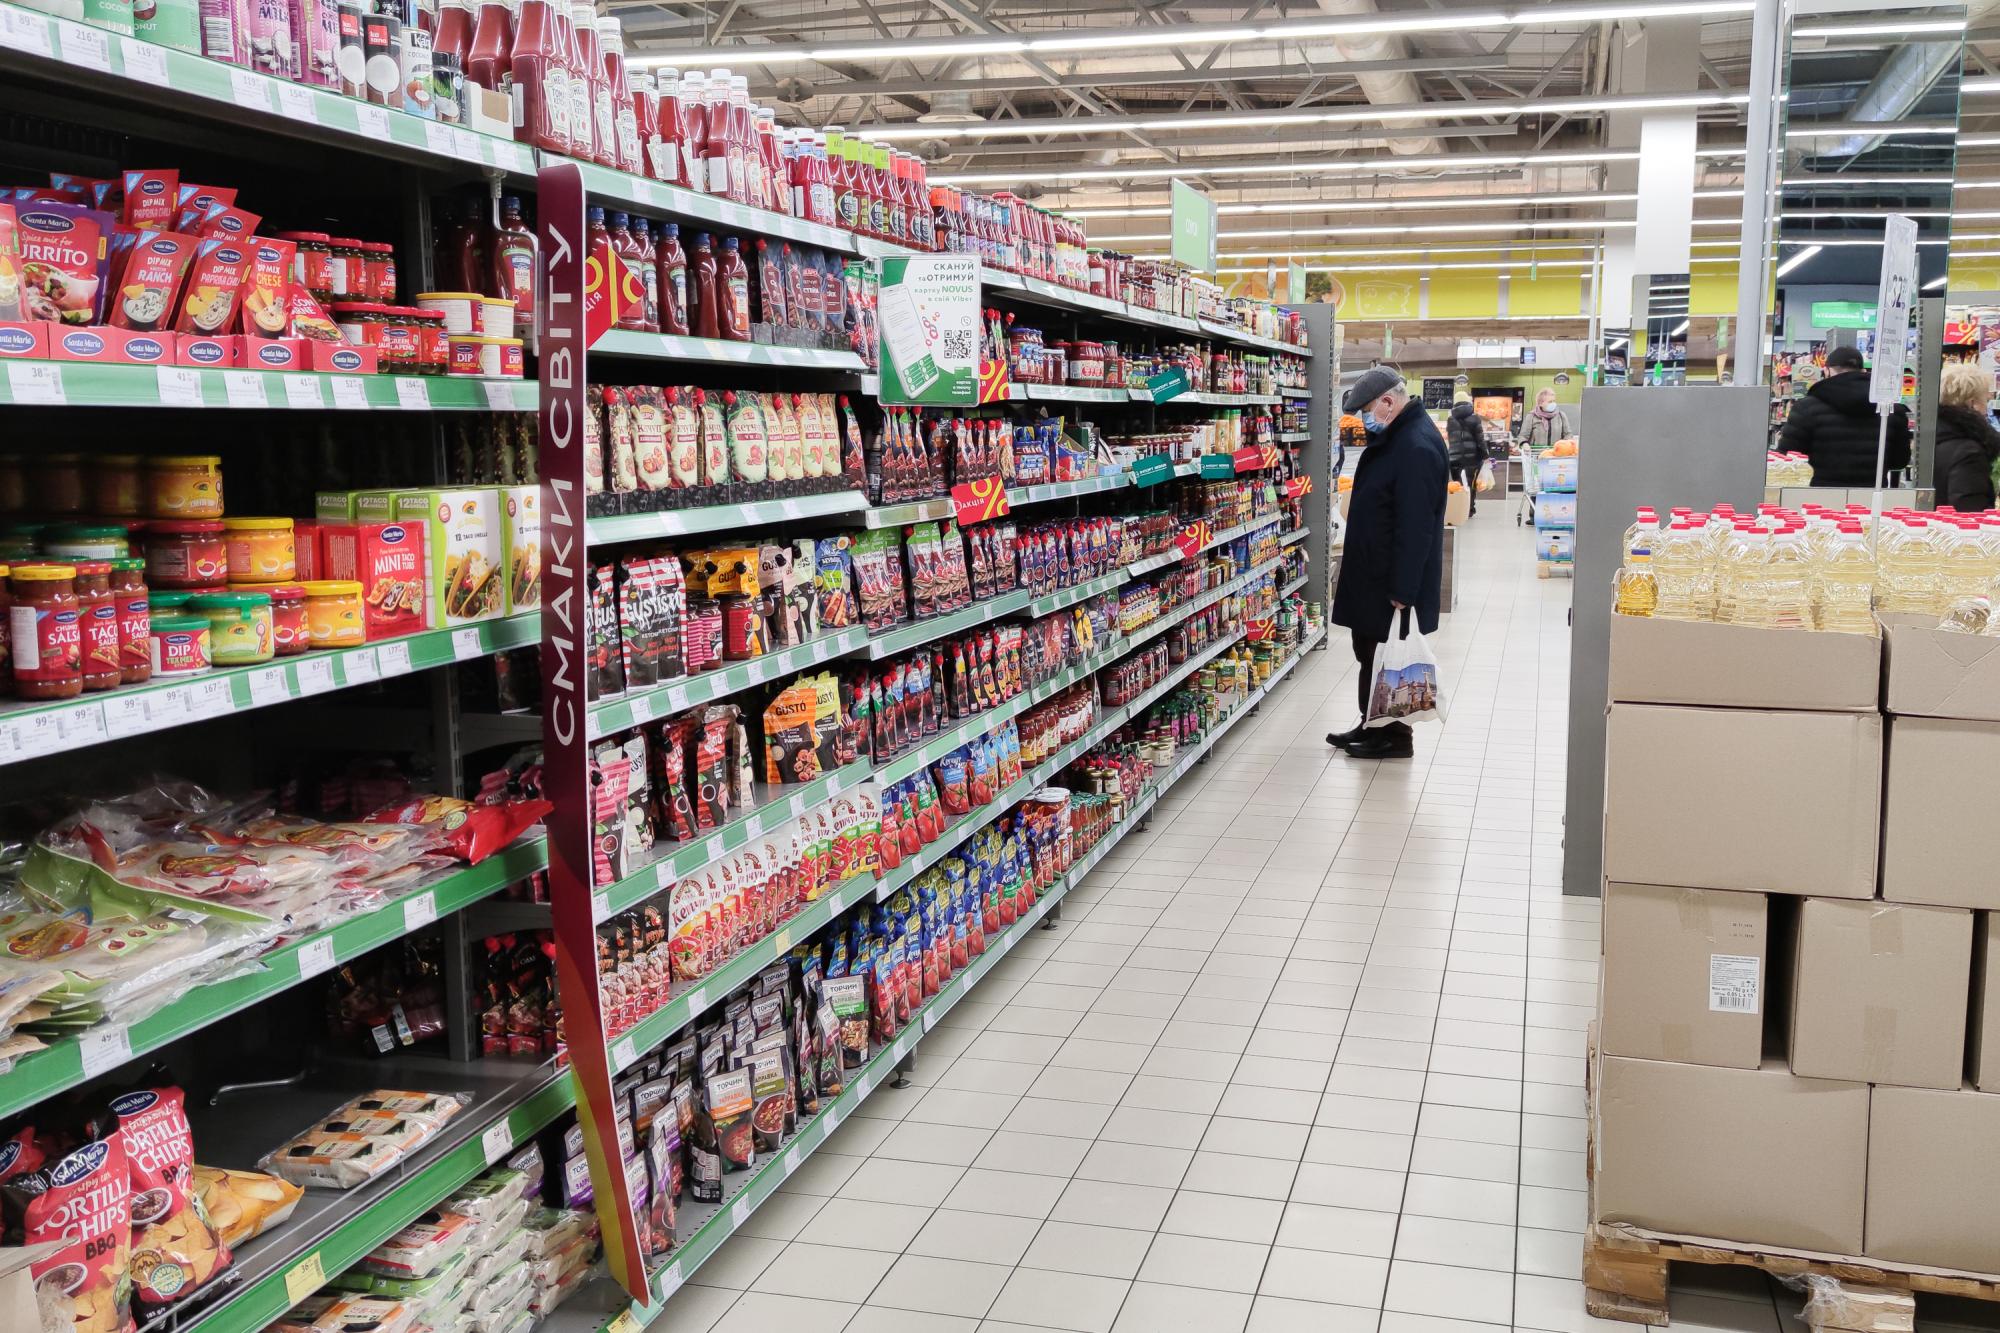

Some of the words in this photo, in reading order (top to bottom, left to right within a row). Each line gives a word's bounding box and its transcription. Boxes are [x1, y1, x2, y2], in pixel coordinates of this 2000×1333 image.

[75, 29, 92, 42] 216
[153, 198, 165, 206] MIX
[24, 216, 46, 227] Santa
[47, 218, 71, 229] Maria
[213, 231, 226, 240] DIP
[43, 235, 58, 245] mix
[59, 234, 74, 249] for
[147, 257, 160, 265] DIP
[160, 258, 173, 266] MIX
[934, 261, 974, 271] СКАНУЙ
[213, 265, 225, 274] DIP
[225, 267, 237, 275] MIX
[268, 265, 281, 274] MIX
[138, 269, 172, 283] RANCH
[201, 274, 225, 285] PAPRIKA
[257, 273, 282, 287] CHEESE
[927, 273, 974, 282] ОТРИМУЙ
[941, 285, 974, 293] NOVUS
[294, 298, 315, 307] CON
[585, 291, 603, 313] ЦІЯ
[952, 294, 973, 302] Viber
[291, 306, 316, 315] ARNE
[16, 335, 33, 346] Maria
[548, 222, 573, 449] СВІТУ
[67, 338, 83, 348] Santa
[84, 339, 102, 349] Maria
[128, 344, 144, 353] Santa
[144, 345, 160, 353] Maria
[191, 347, 206, 356] Santa
[206, 348, 221, 357] Maria
[262, 350, 275, 358] Santa
[276, 350, 290, 359] Maria
[457, 353, 474, 363] DIP
[509, 355, 521, 364] DIP
[32, 367, 43, 378] 38
[369, 496, 388, 504] TACO
[399, 497, 409, 508] 12
[409, 497, 429, 505] TACO
[455, 533, 462, 541] 12
[401, 554, 415, 563] TACO
[375, 556, 401, 577] MINI
[401, 561, 415, 570] TUBS
[551, 479, 575, 745] СМАКИ
[122, 618, 150, 634] TACO
[48, 631, 80, 645] SALSA
[89, 624, 118, 641] TACO
[168, 645, 191, 657] DIP
[265, 672, 274, 681] 89
[204, 684, 217, 693] 167
[167, 691, 177, 701] 99
[816, 692, 835, 705] USTÓ
[124, 699, 135, 709] 99
[775, 700, 807, 716] GUSTÓ
[75, 710, 87, 720] 99
[35, 717, 47, 728] 99
[830, 982, 858, 993] ТОРЧИН
[755, 1059, 776, 1070] ОРЧИН
[755, 1072, 778, 1083] АПРАВКА
[717, 1077, 743, 1091] ТОРЧИН
[640, 1087, 666, 1100] ТОРЧИН
[113, 1098, 133, 1113] Santa
[133, 1094, 153, 1108] Maria
[123, 1113, 190, 1156] ORTILLA
[138, 1137, 191, 1174] CHIPS
[57, 1159, 83, 1185] Santa
[81, 1146, 105, 1170] Maria
[62, 1201, 128, 1245] CHIPS
[85, 1233, 117, 1261] BBQ
